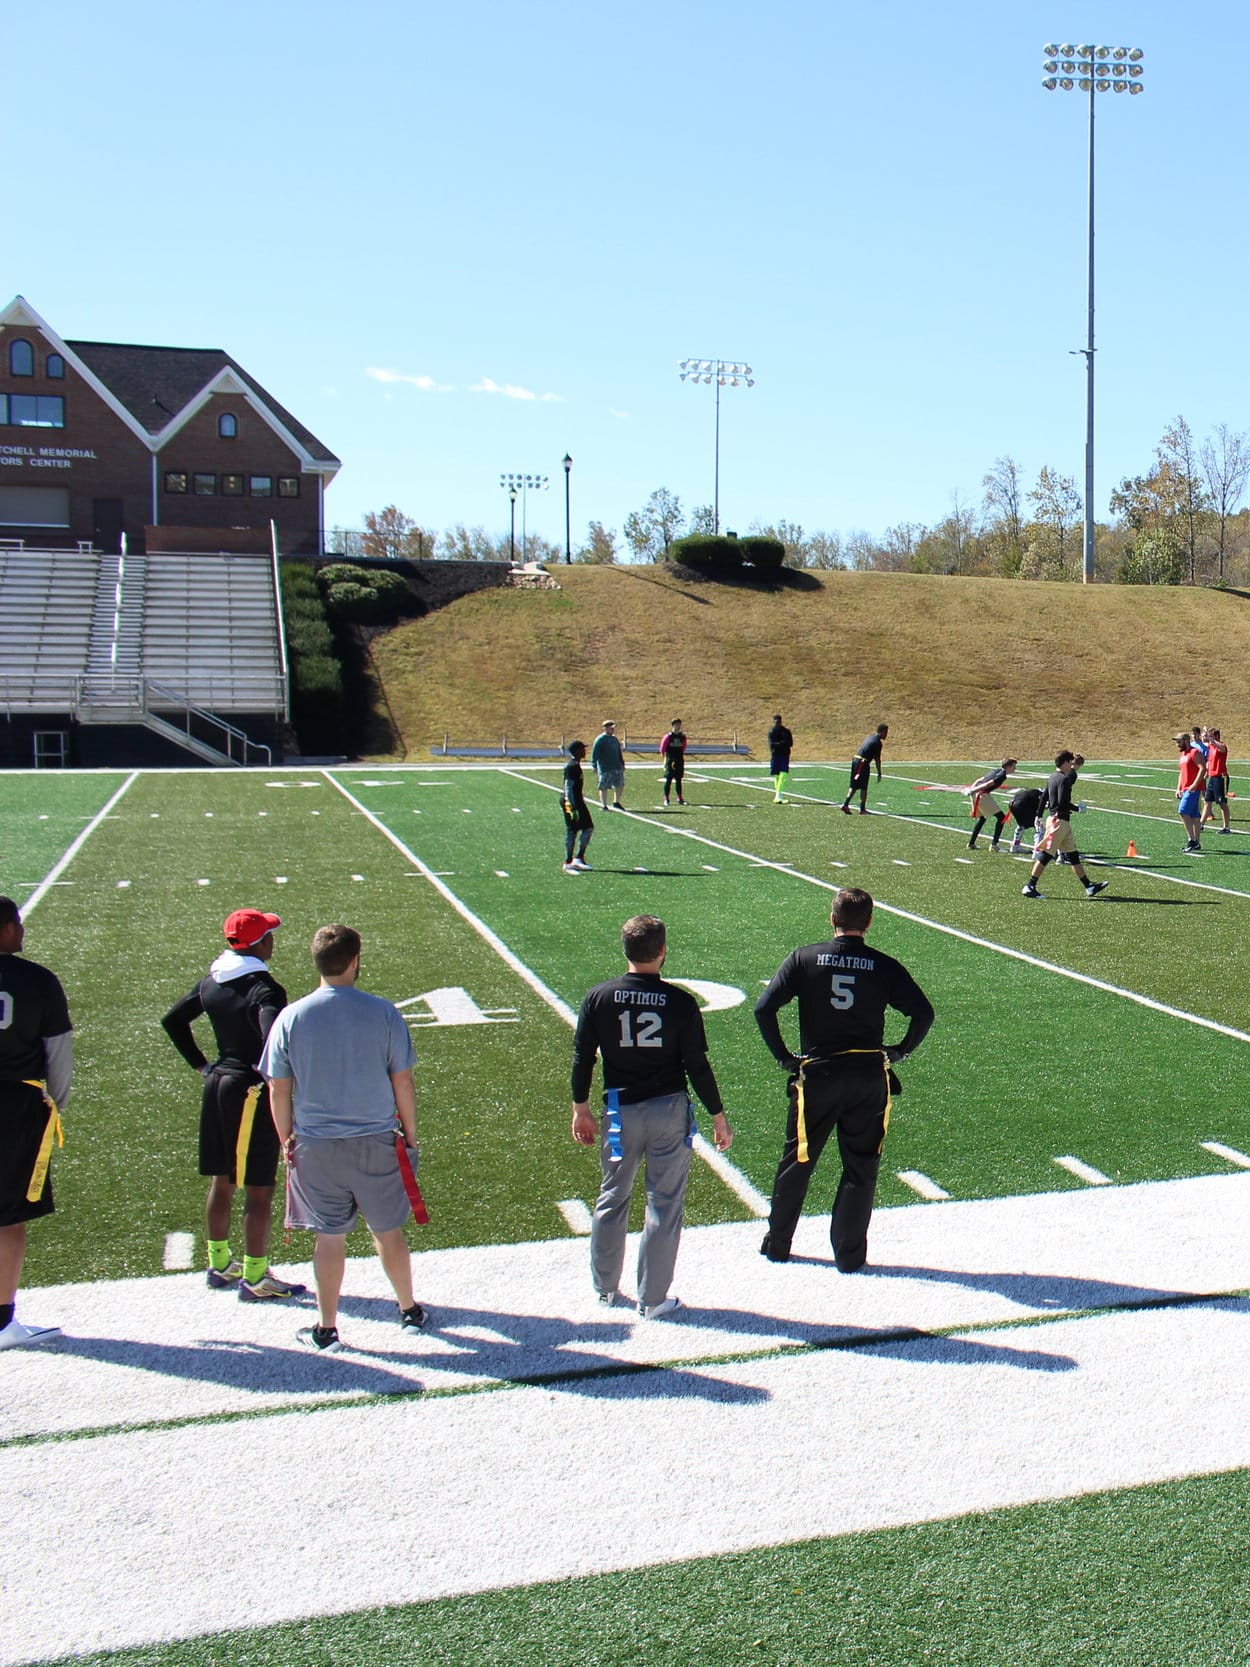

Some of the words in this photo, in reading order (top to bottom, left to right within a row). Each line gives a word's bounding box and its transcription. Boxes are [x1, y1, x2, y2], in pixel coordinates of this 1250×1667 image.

[39, 447, 97, 459] MEMORIAL
[30, 458, 72, 468] CENTER
[816, 953, 874, 971] MEGATRON
[614, 989, 667, 1007] OPTIMUS
[831, 974, 855, 1010] 5
[618, 1010, 662, 1048] 12
